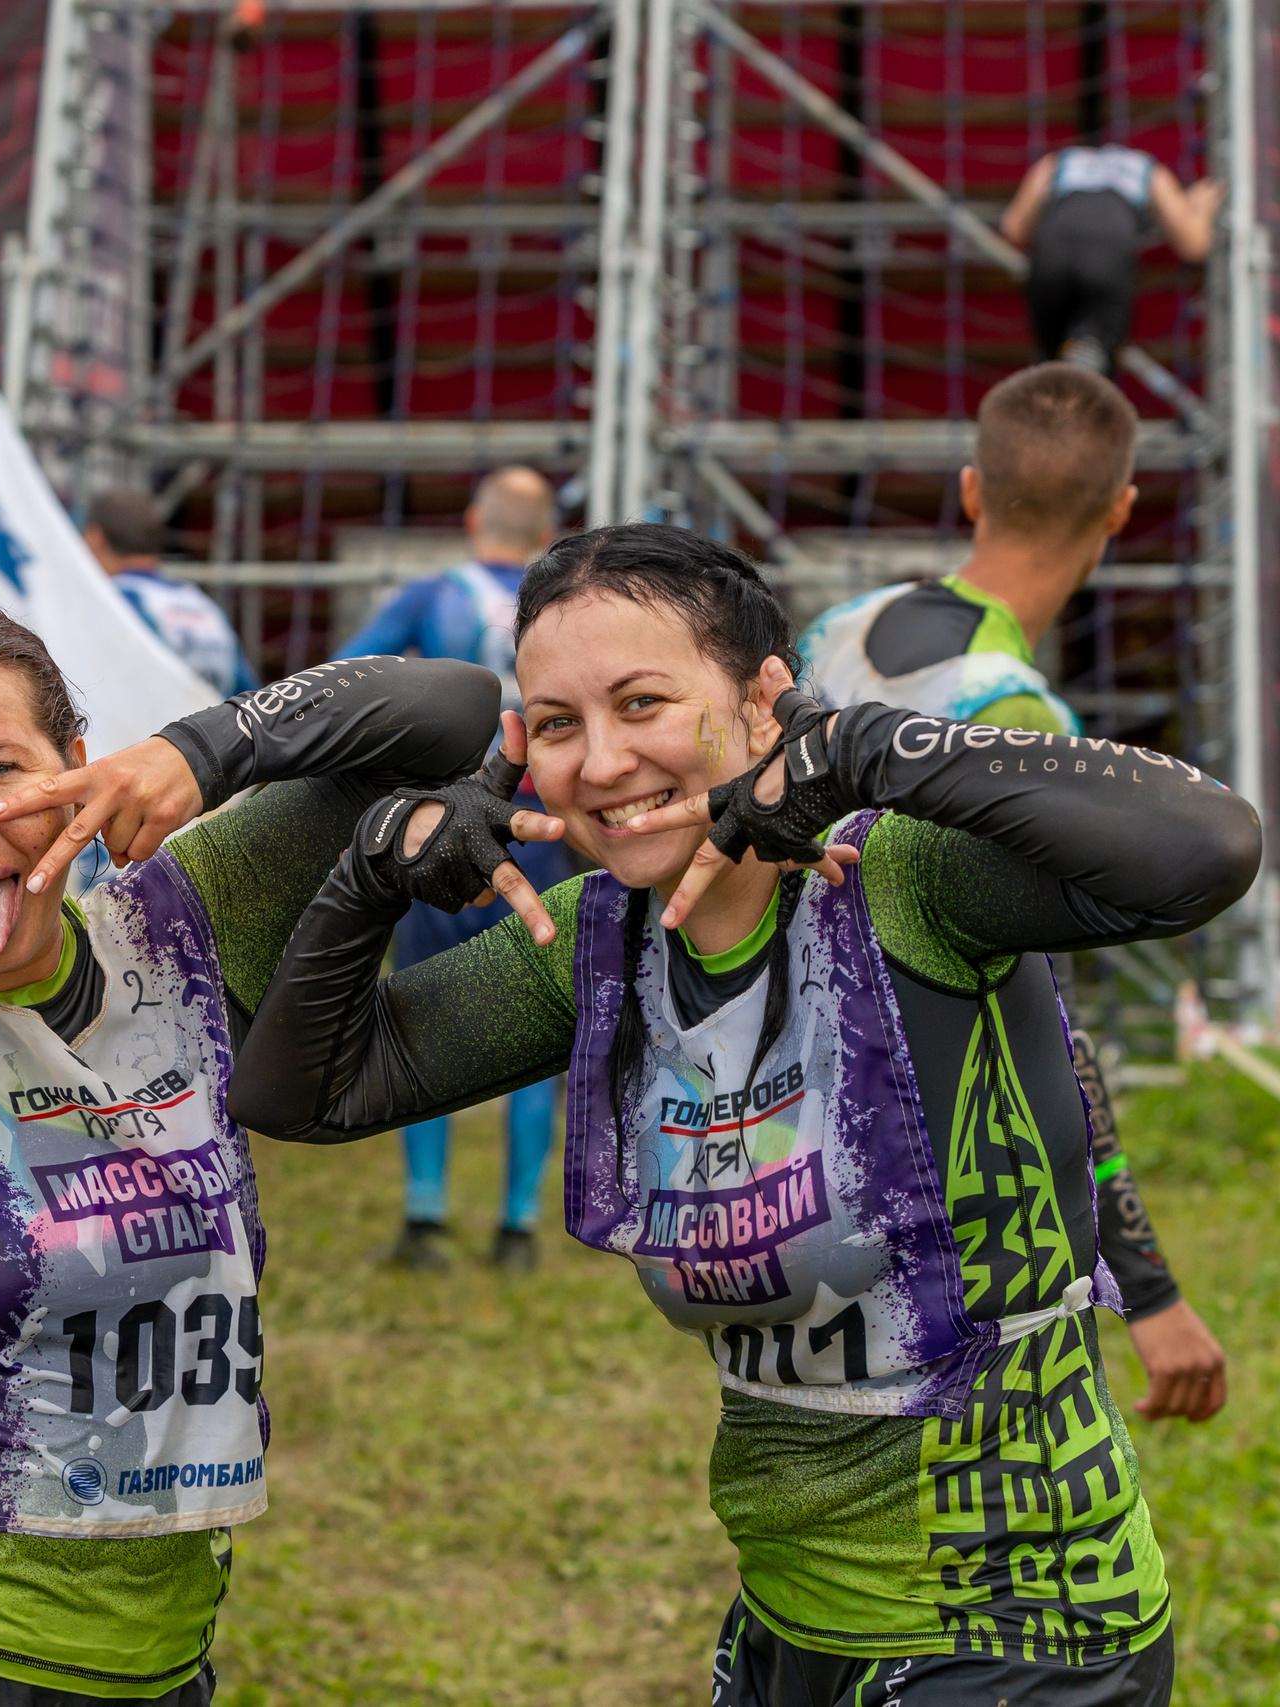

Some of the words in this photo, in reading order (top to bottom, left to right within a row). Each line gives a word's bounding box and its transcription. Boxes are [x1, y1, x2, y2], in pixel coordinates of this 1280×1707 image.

[294, 665, 383, 721] GLOBAL
[988, 757, 1143, 783] GLOBAL
[47, 1148, 232, 1211] МАССОВЫ
[645, 1152, 818, 1250] МАССОВЫЙ
[680, 1253, 777, 1301] СТАРТ
[118, 1454, 263, 1496] ГАЗПРОМБАНК
